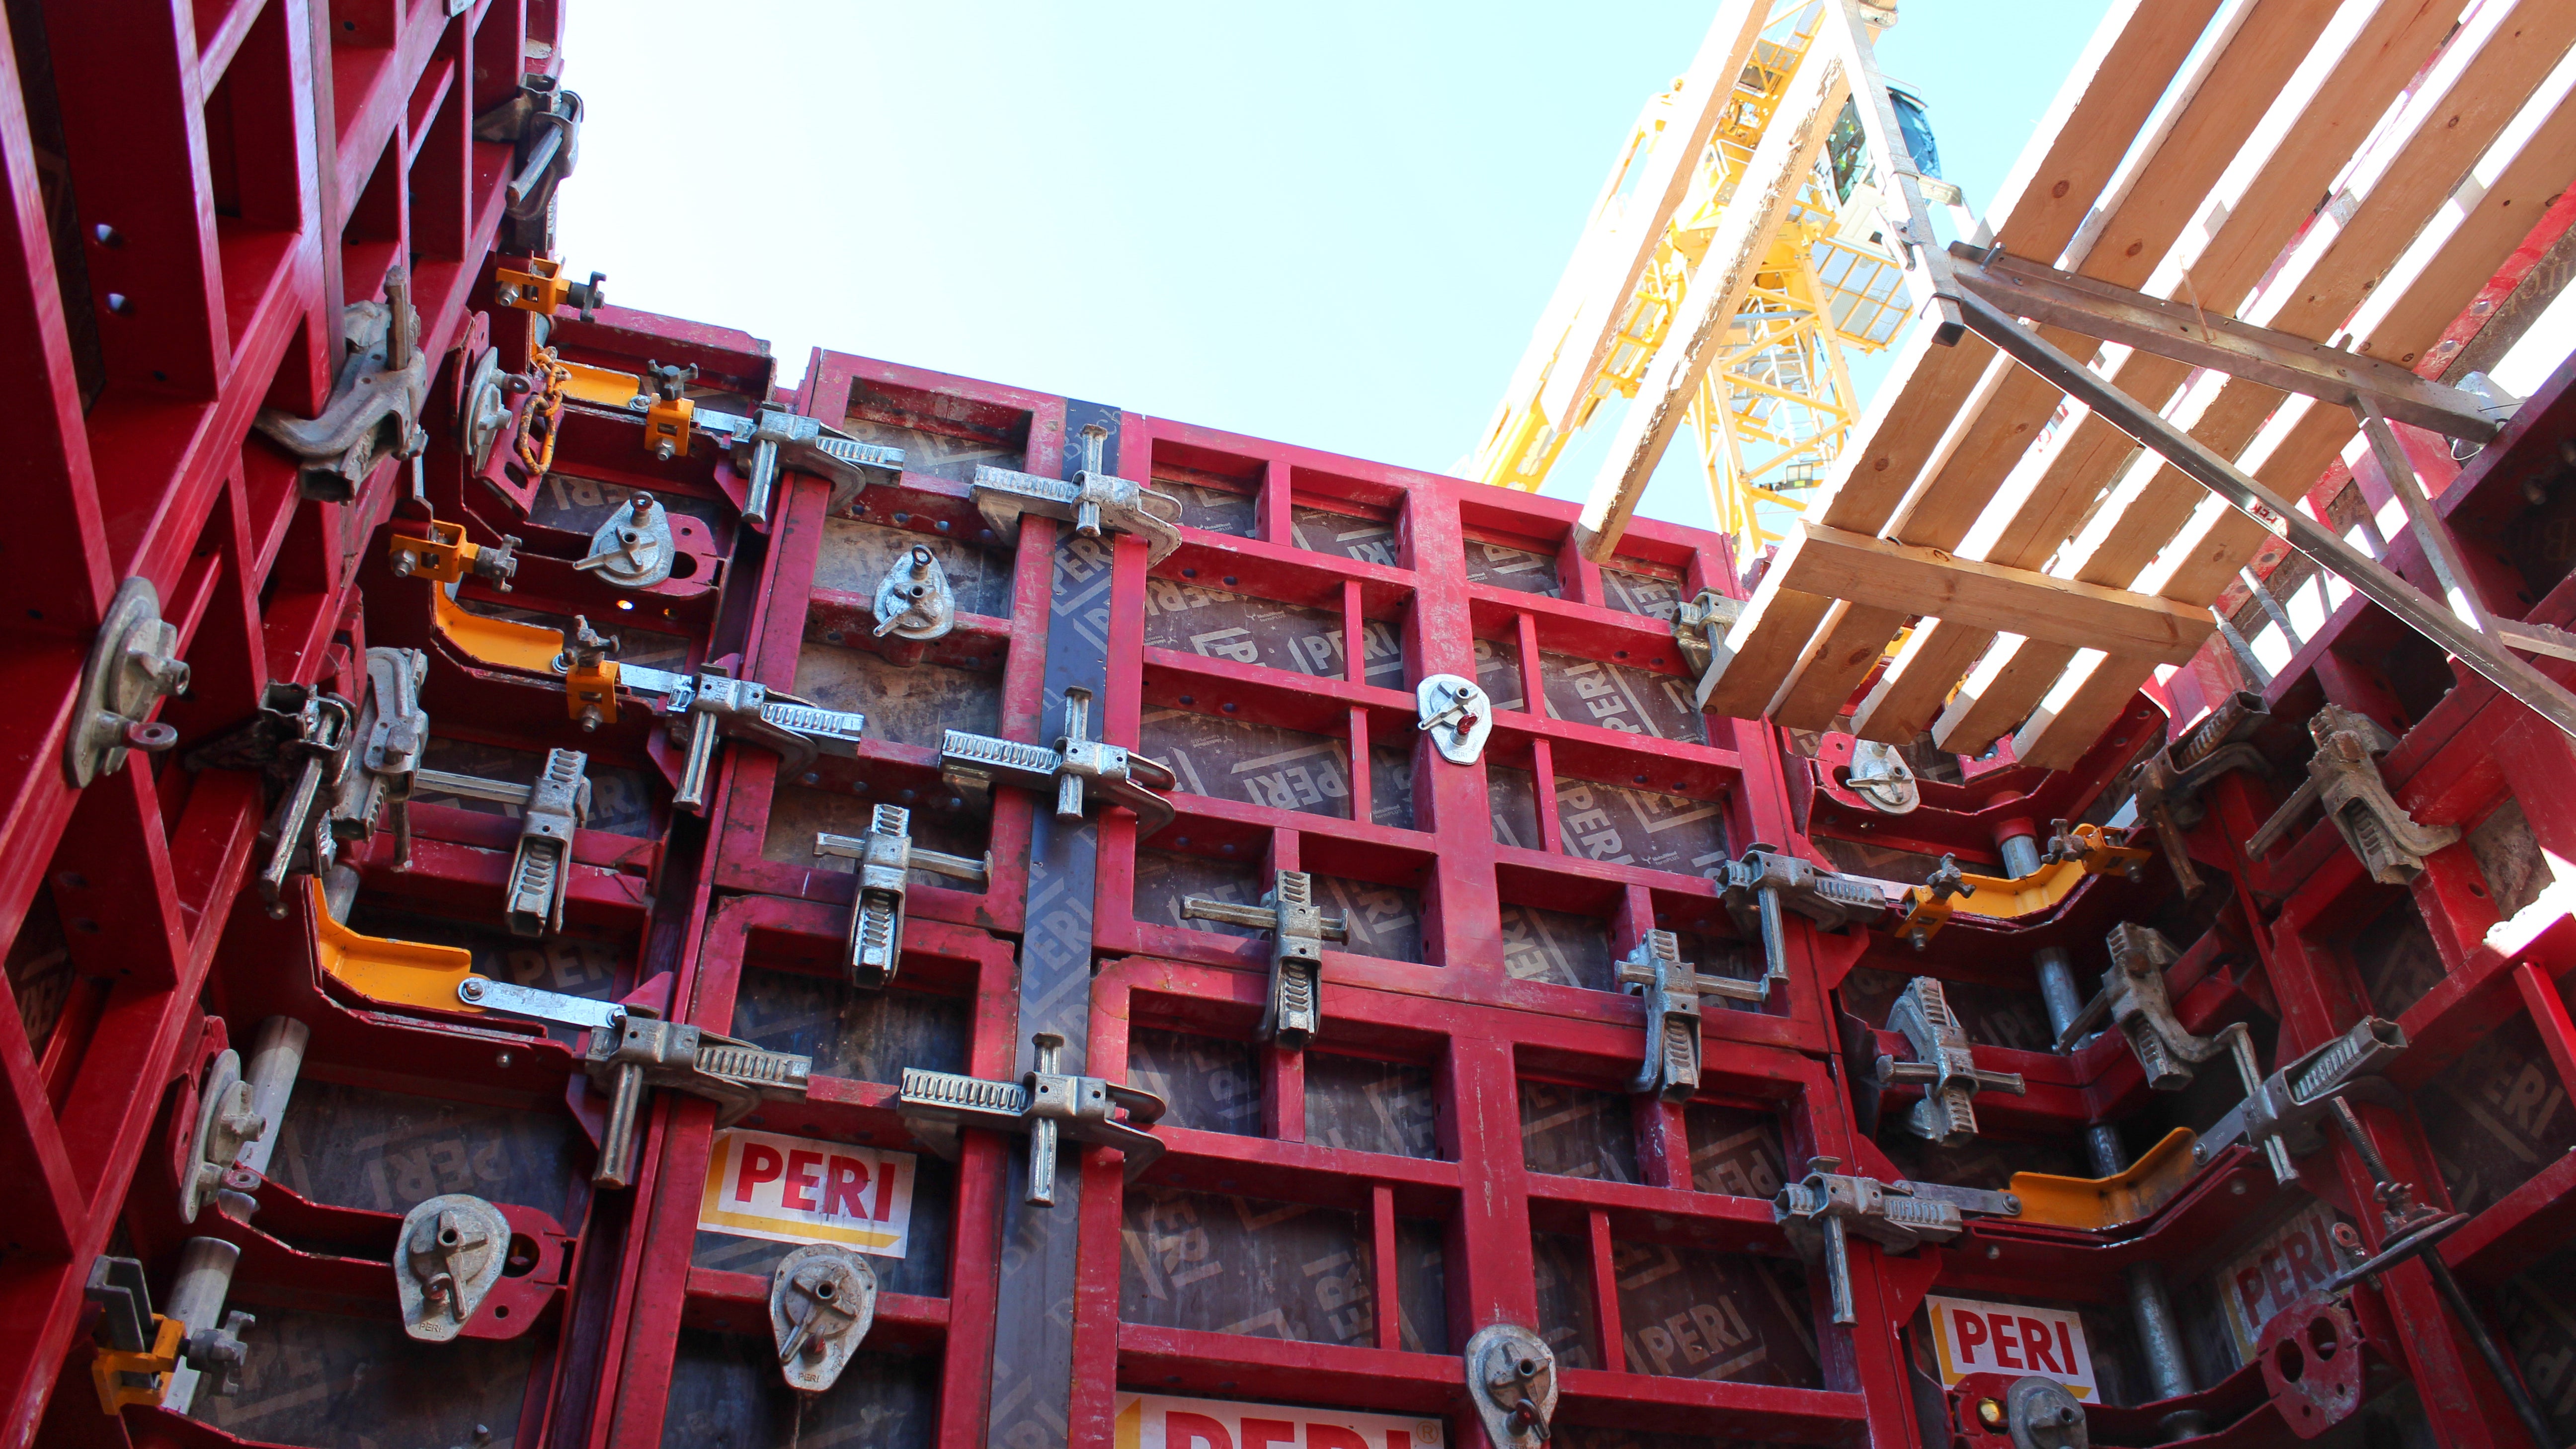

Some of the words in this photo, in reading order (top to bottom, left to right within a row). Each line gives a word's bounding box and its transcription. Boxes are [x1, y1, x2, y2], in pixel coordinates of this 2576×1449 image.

[1300, 623, 1399, 675] PRI
[715, 678, 730, 702] PERI
[1243, 760, 1348, 807] PERI
[1552, 785, 1635, 866] PERI
[735, 1142, 896, 1222] PERI
[2237, 1214, 2338, 1330] PERI
[419, 1322, 443, 1333] PERI
[1639, 1294, 1753, 1374] PERI
[1952, 1309, 2079, 1375] PERI
[798, 1372, 820, 1383] PERI
